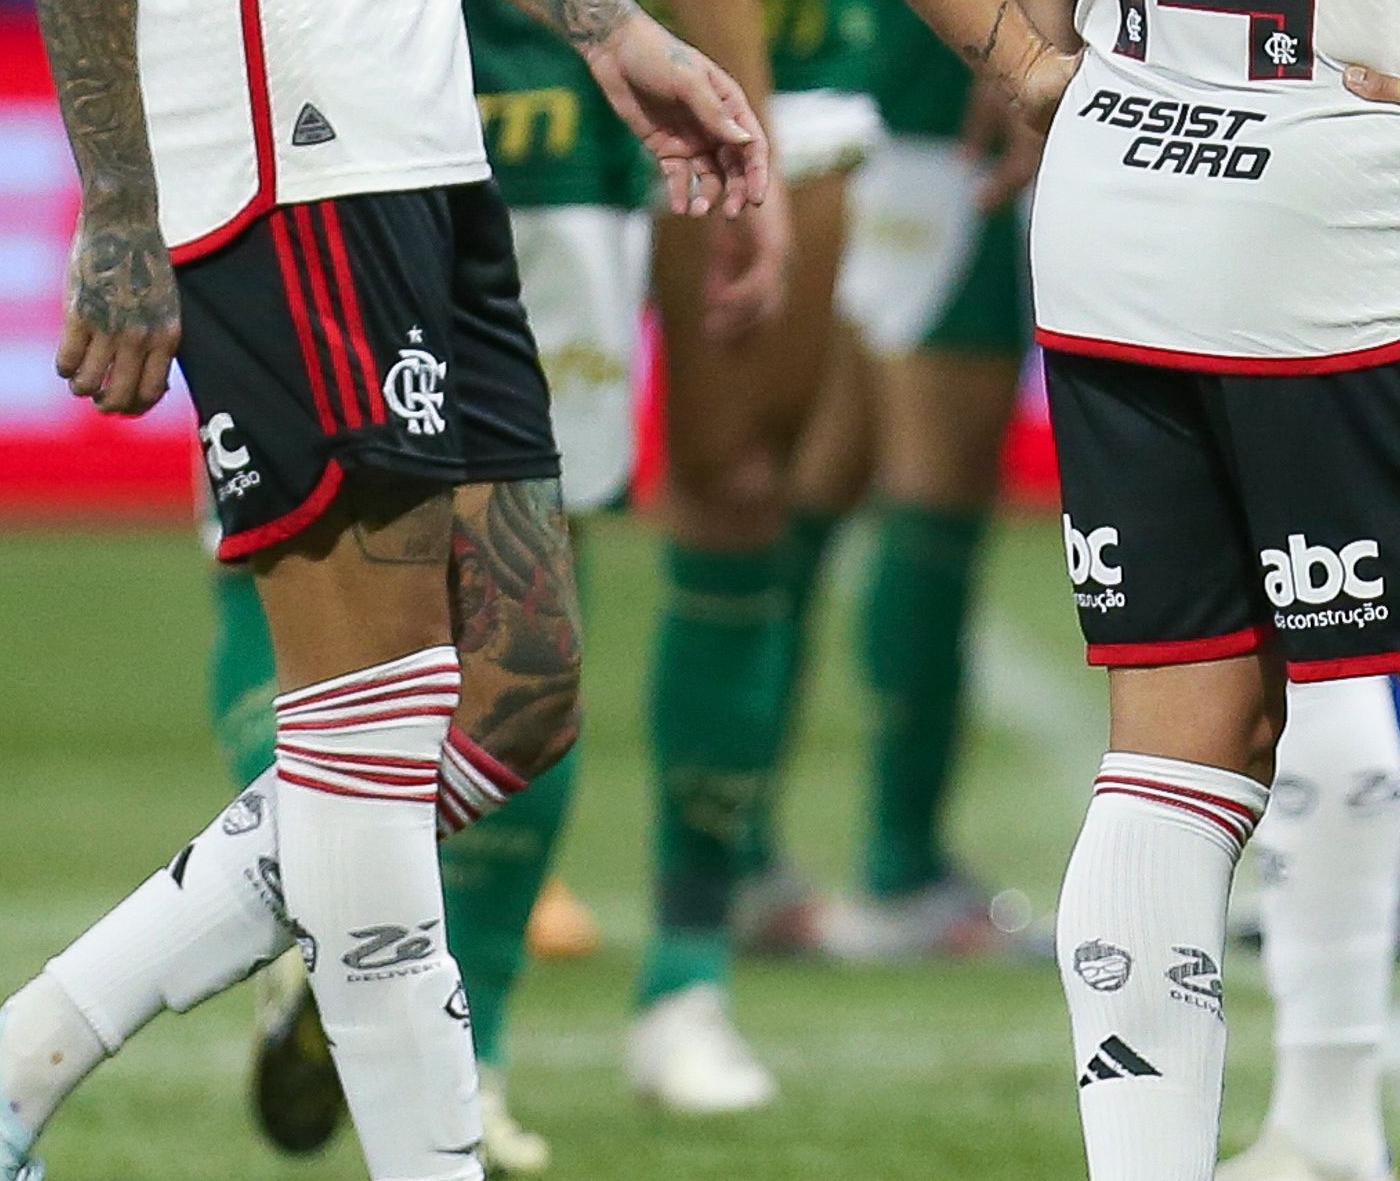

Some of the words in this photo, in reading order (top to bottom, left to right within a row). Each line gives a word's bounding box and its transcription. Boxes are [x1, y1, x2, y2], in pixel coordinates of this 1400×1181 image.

[1077, 89, 1268, 141] ASSIST
[1122, 136, 1272, 180] CARD
[1063, 513, 1122, 586] bc
[1260, 534, 1384, 608] abc
[1287, 602, 1389, 629] construção
